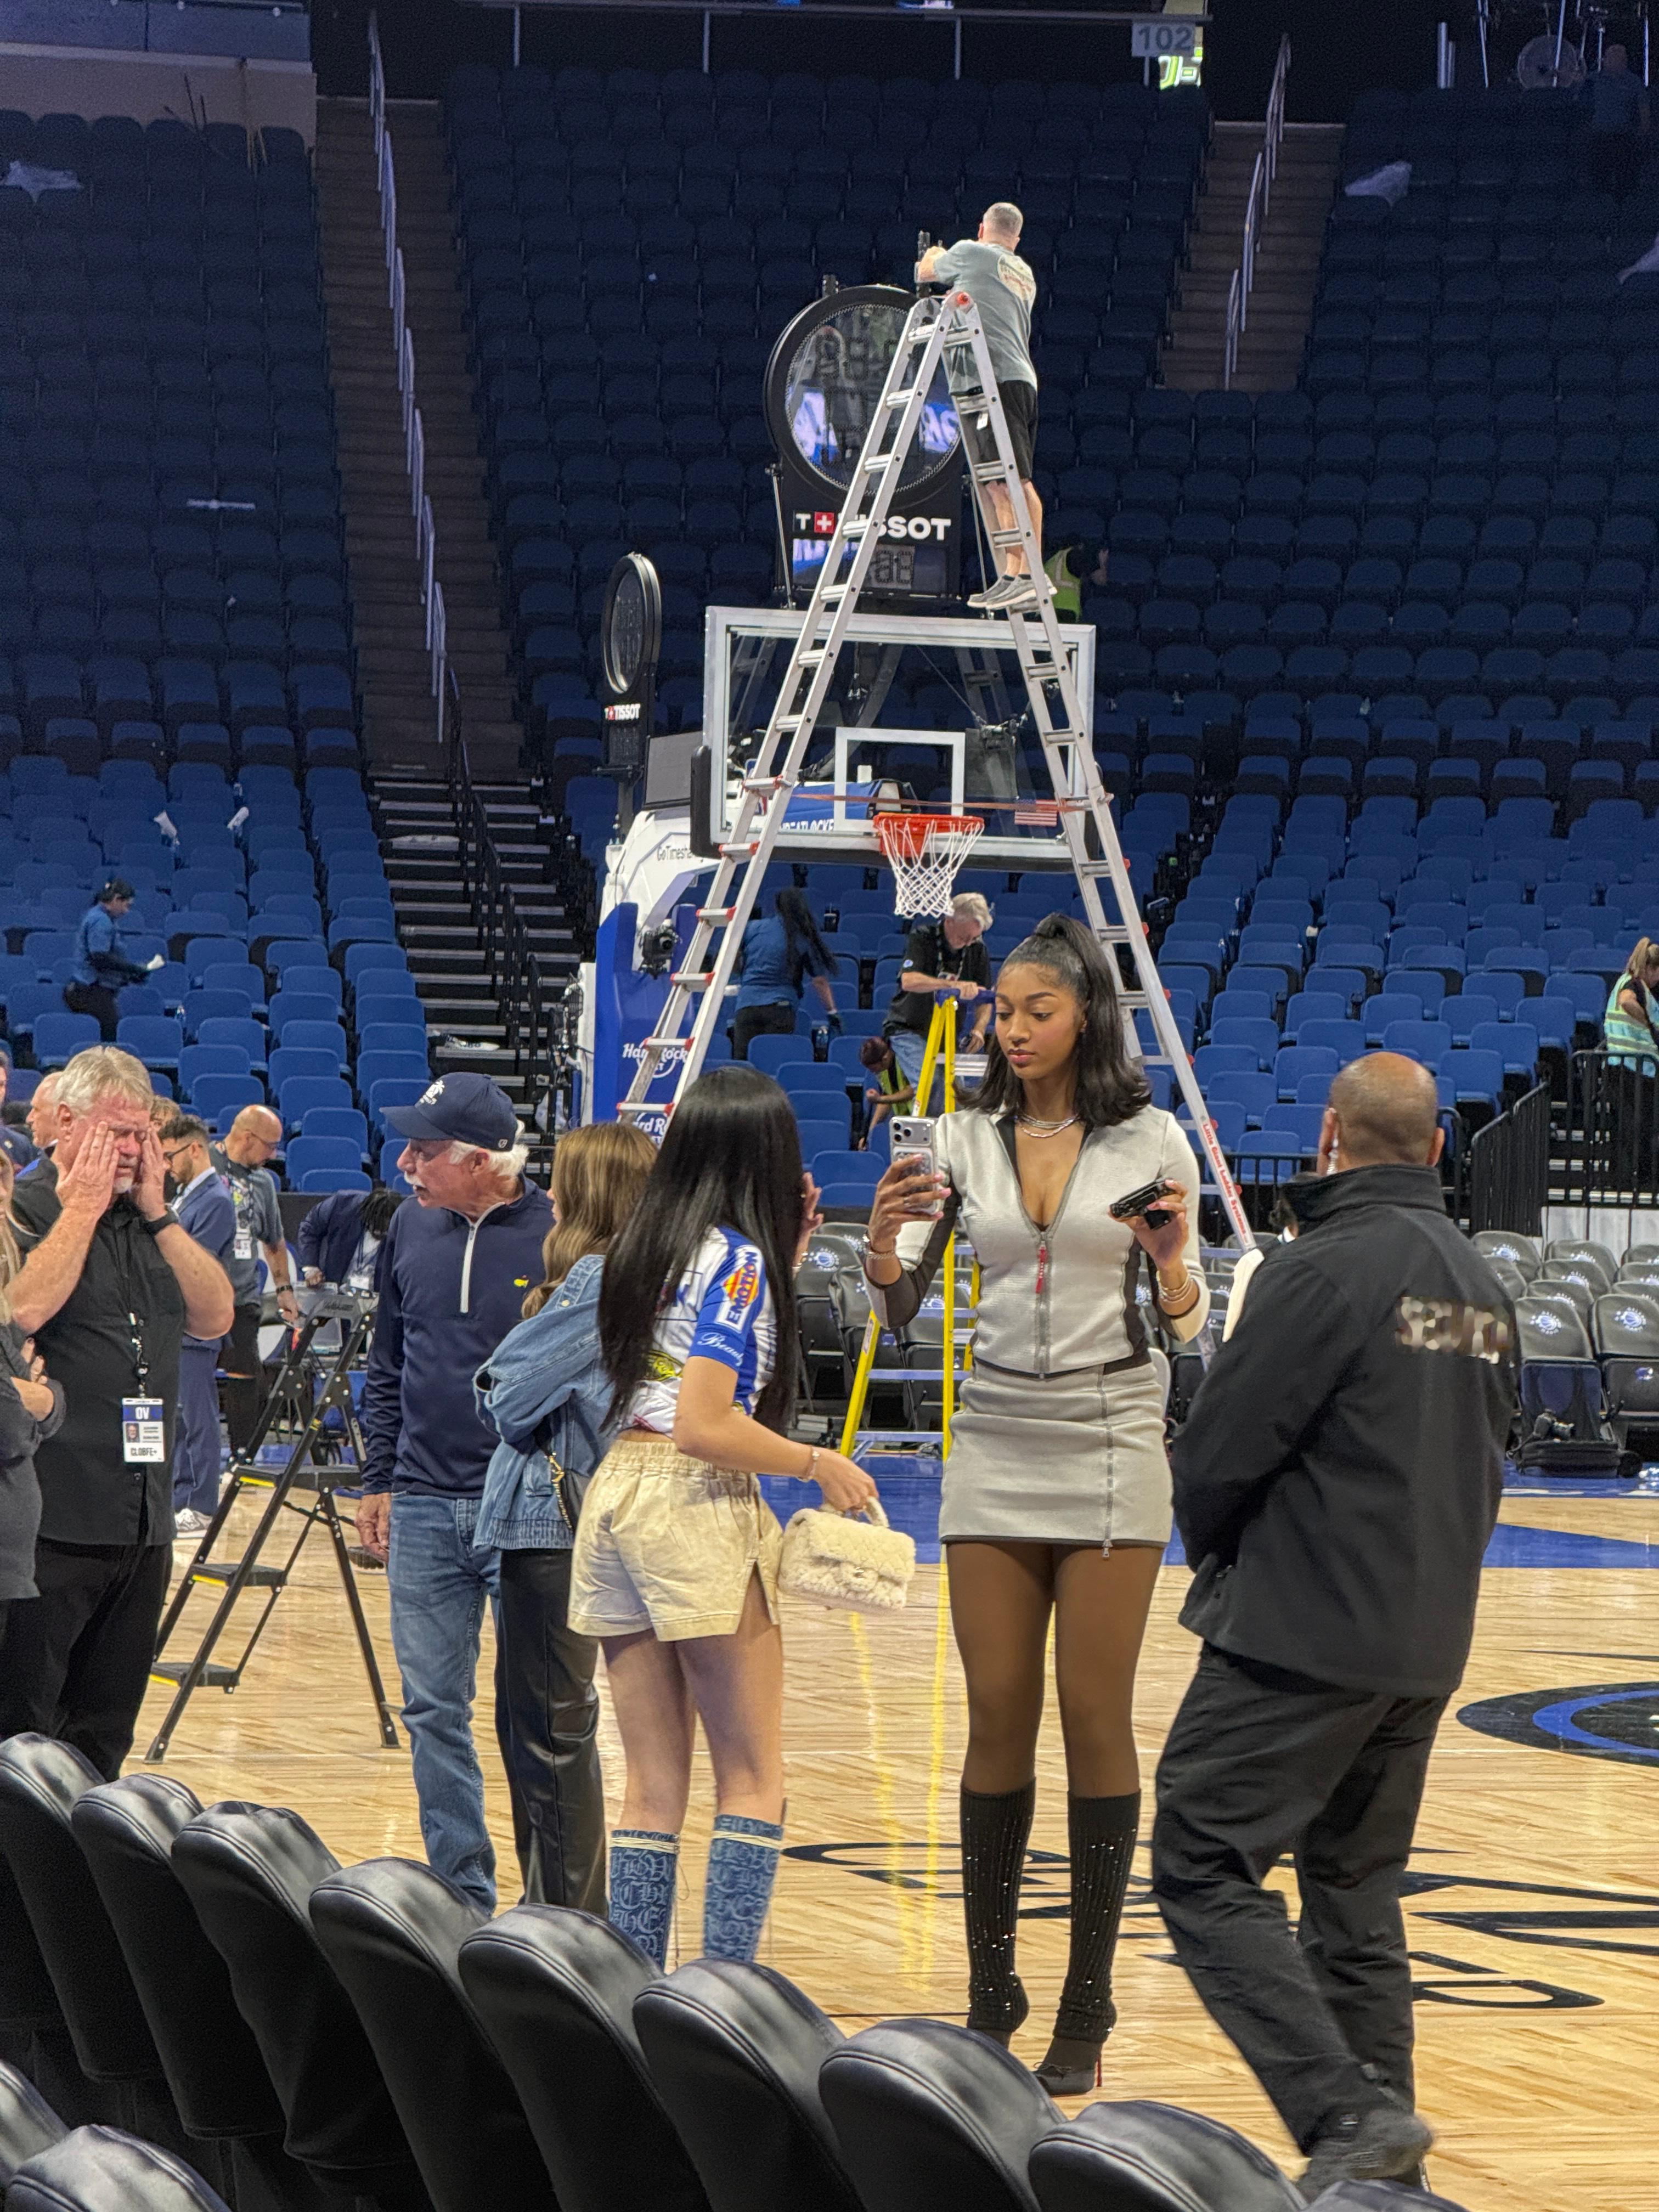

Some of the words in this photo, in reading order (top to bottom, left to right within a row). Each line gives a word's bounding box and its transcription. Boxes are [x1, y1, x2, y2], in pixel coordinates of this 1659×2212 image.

[1138, 25, 1192, 51] 102
[614, 703, 641, 720] TISSOT
[622, 1043, 648, 1058] Har
[726, 1251, 758, 1323] EMOTION
[135, 1407, 149, 1420] OV
